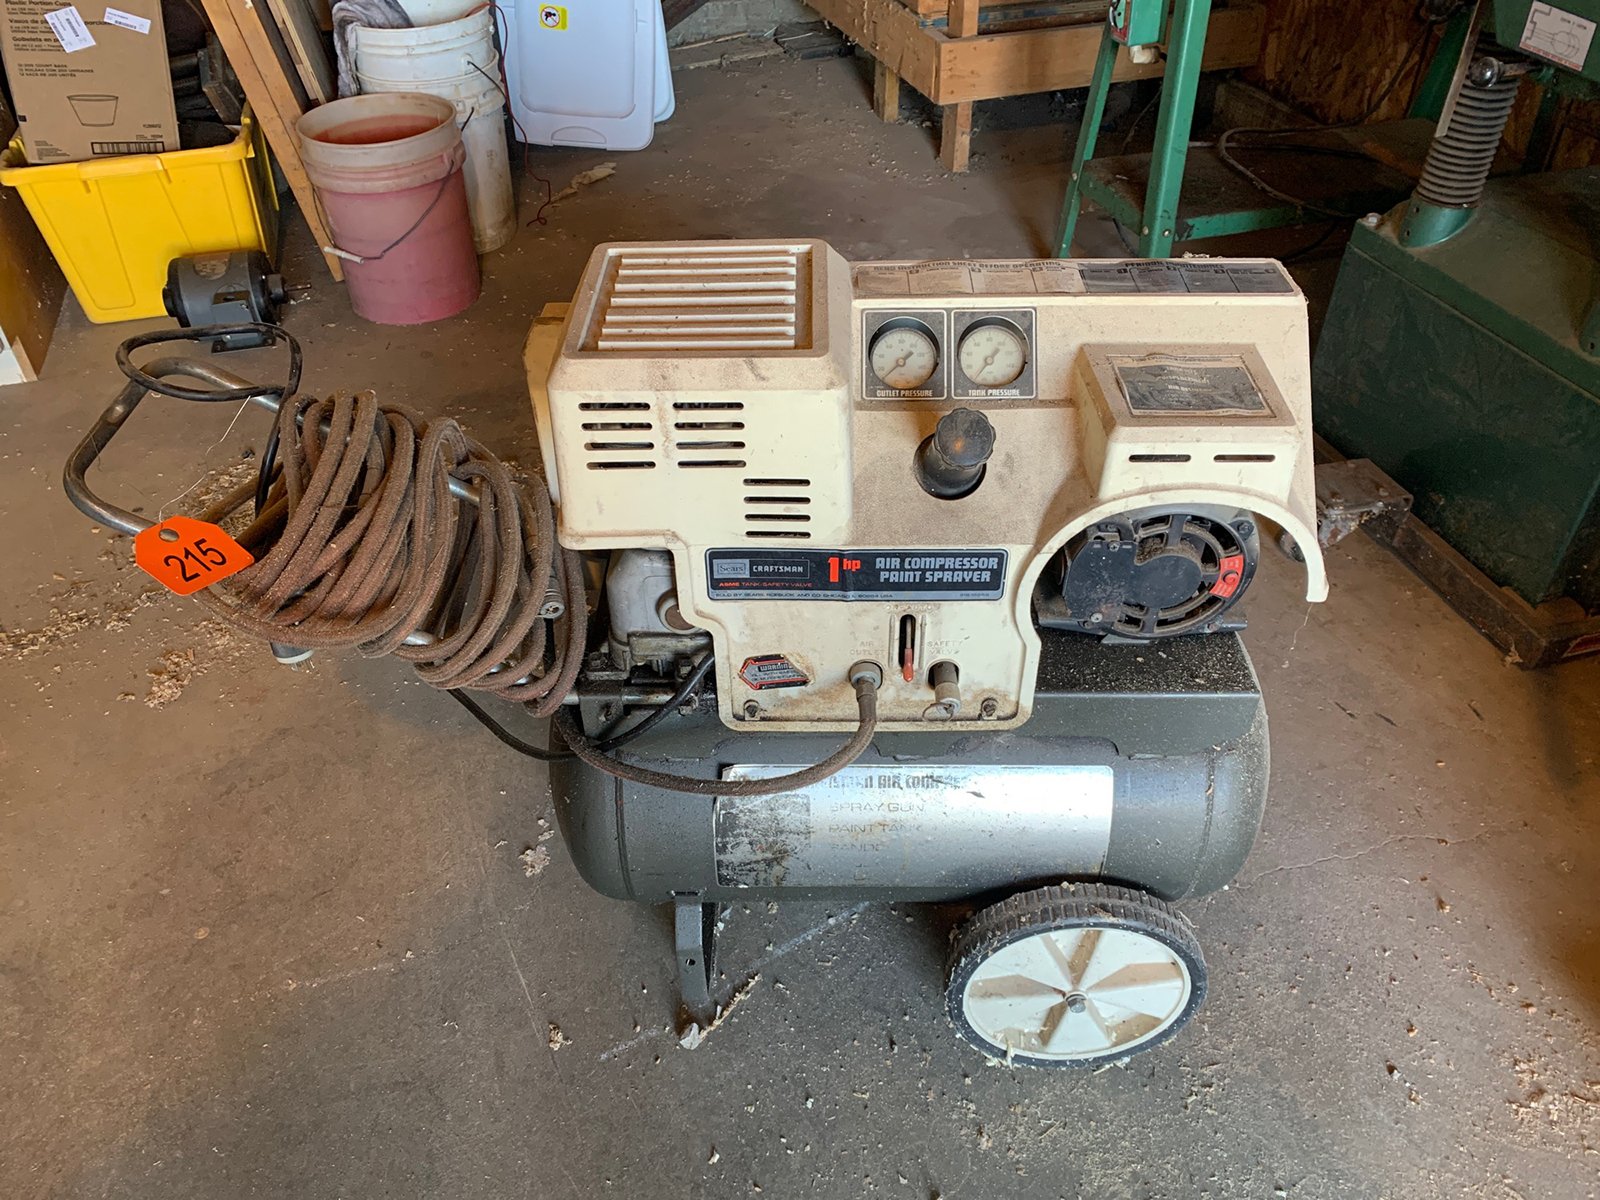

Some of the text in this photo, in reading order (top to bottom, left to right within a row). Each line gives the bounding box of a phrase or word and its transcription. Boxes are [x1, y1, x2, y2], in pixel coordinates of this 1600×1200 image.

[163, 538, 227, 582] 215
[875, 557, 999, 569] AIR COMPRESSOR
[719, 565, 744, 573] Sears
[752, 565, 804, 573] CRAFTSMAN
[828, 556, 862, 583] 1 hp
[879, 571, 992, 583] PAINT SPRAYER
[831, 803, 884, 812] SPRAY
[829, 824, 874, 833] PAINT
